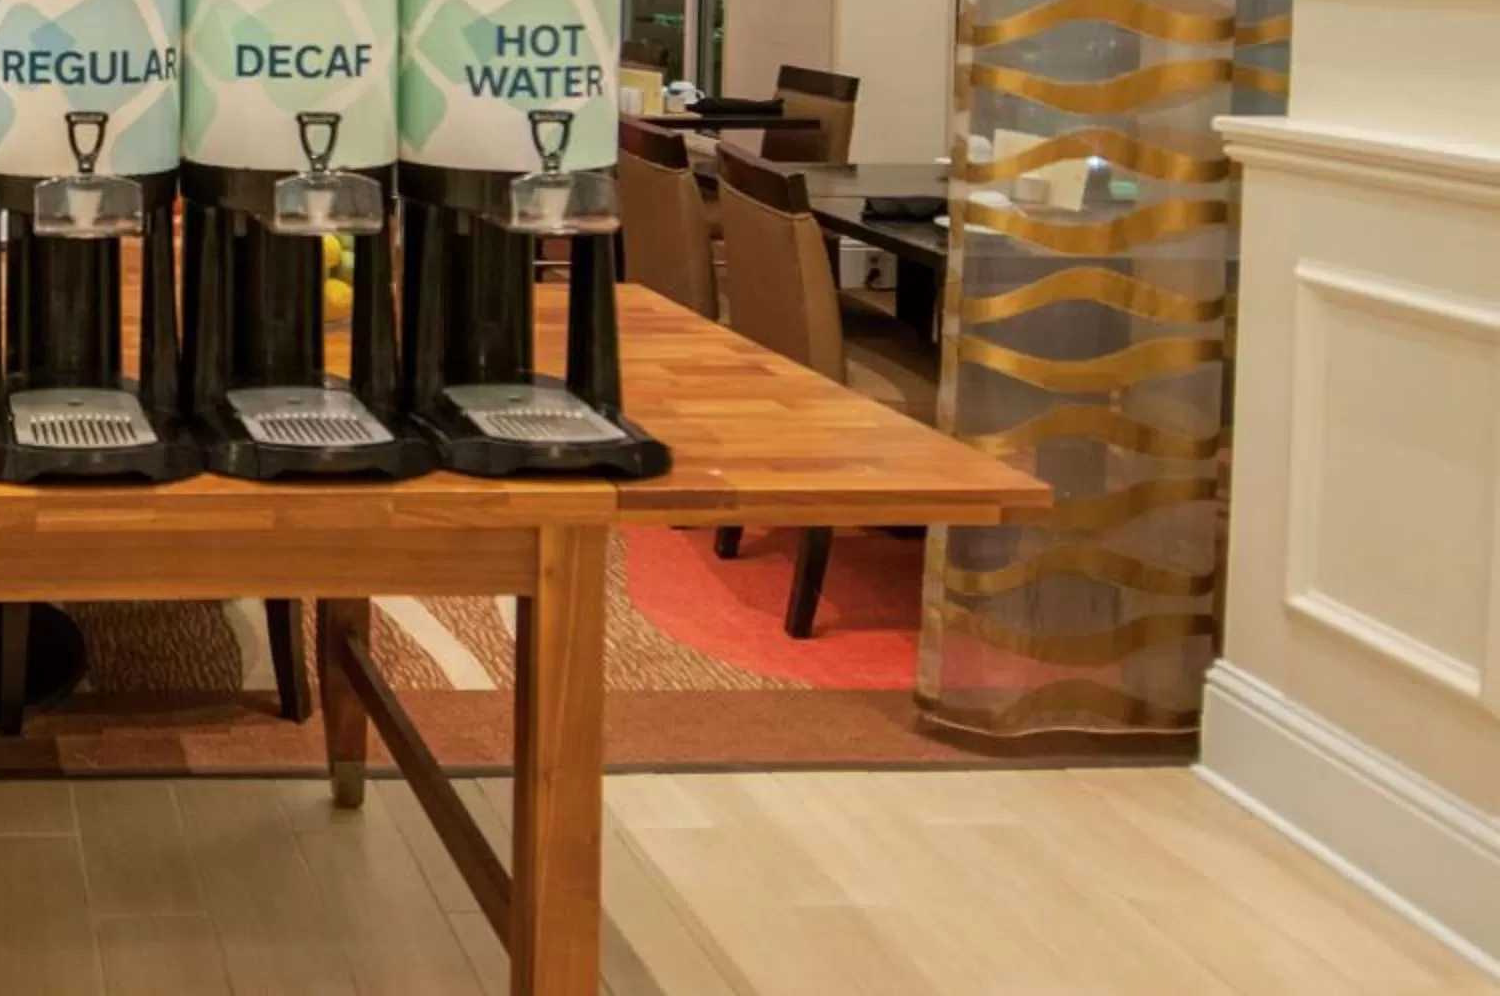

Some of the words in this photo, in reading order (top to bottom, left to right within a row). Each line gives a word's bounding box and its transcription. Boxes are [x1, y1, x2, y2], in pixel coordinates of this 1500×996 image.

[496, 24, 585, 57] HOT
[2, 46, 178, 85] REGULAR
[236, 44, 372, 78] DECAF
[465, 64, 604, 98] WATER
